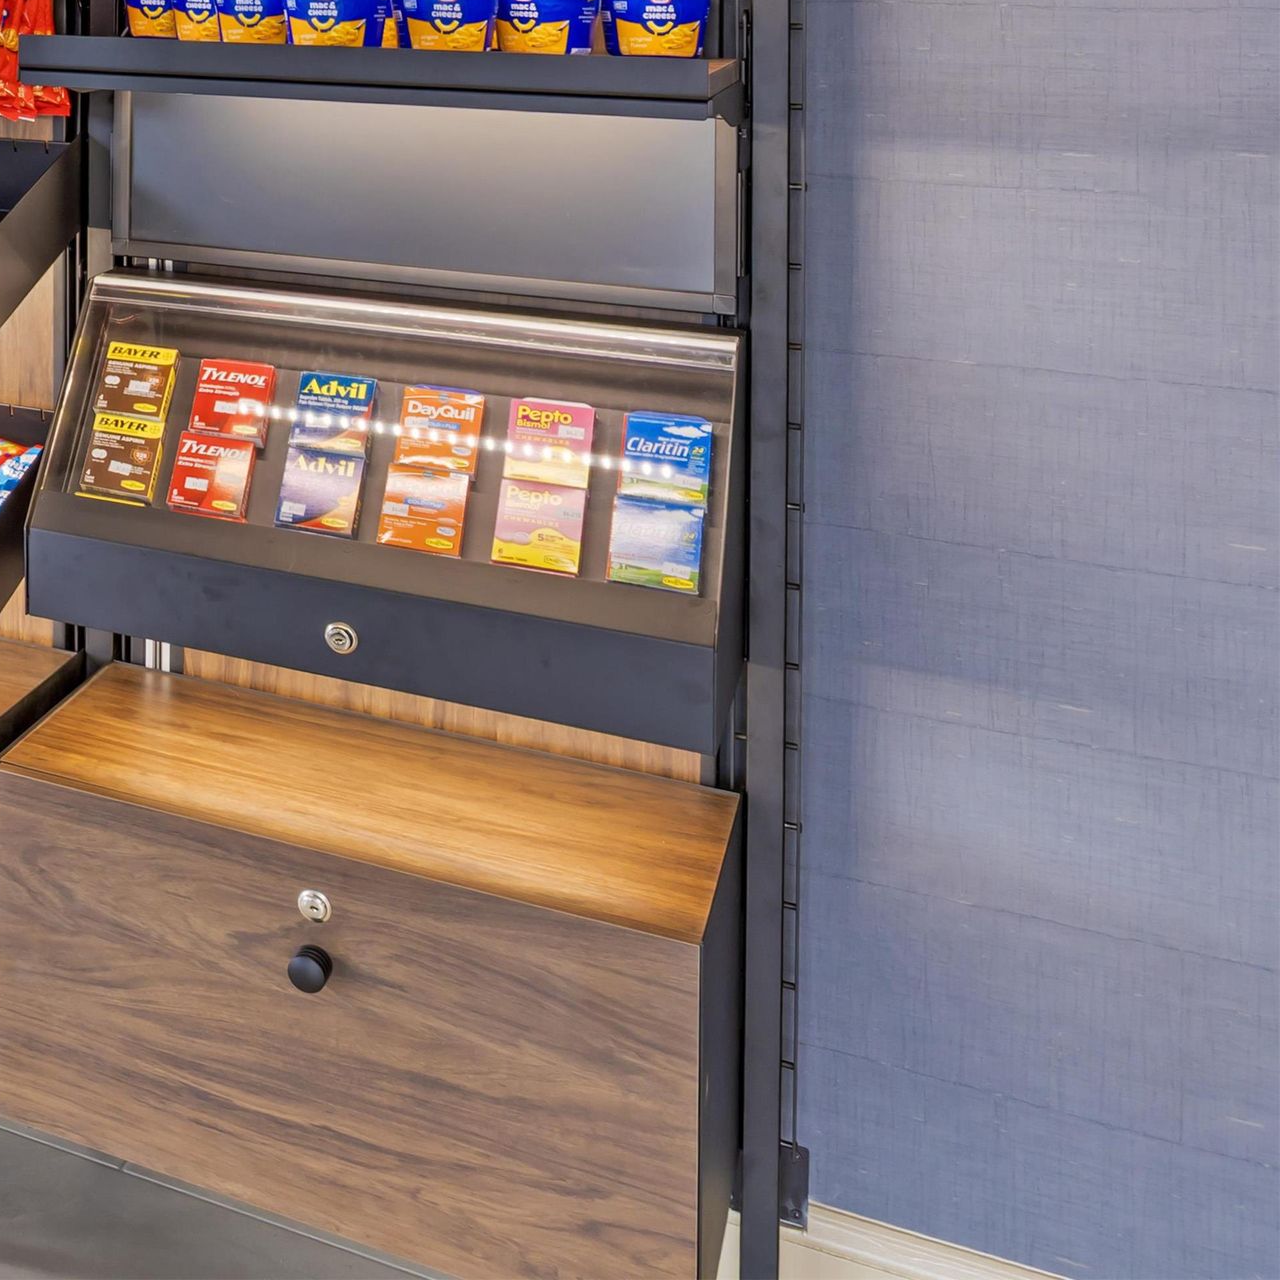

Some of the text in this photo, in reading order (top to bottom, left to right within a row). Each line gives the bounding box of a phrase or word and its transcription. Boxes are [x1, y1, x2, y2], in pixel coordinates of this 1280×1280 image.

[433, 3, 461, 11] mac &
[510, 3, 538, 11] mac &
[668, 4, 674, 12] &
[111, 346, 161, 360] BAYER
[201, 367, 268, 387] TYLENOL
[301, 378, 367, 400] Advil
[407, 399, 475, 422] DayQuil
[517, 405, 572, 425] Pepto
[98, 417, 148, 433] BAYER
[516, 419, 550, 430] Bismol
[626, 436, 689, 457] Claritin
[294, 454, 356, 478] Advil
[507, 485, 563, 506] Pepto
